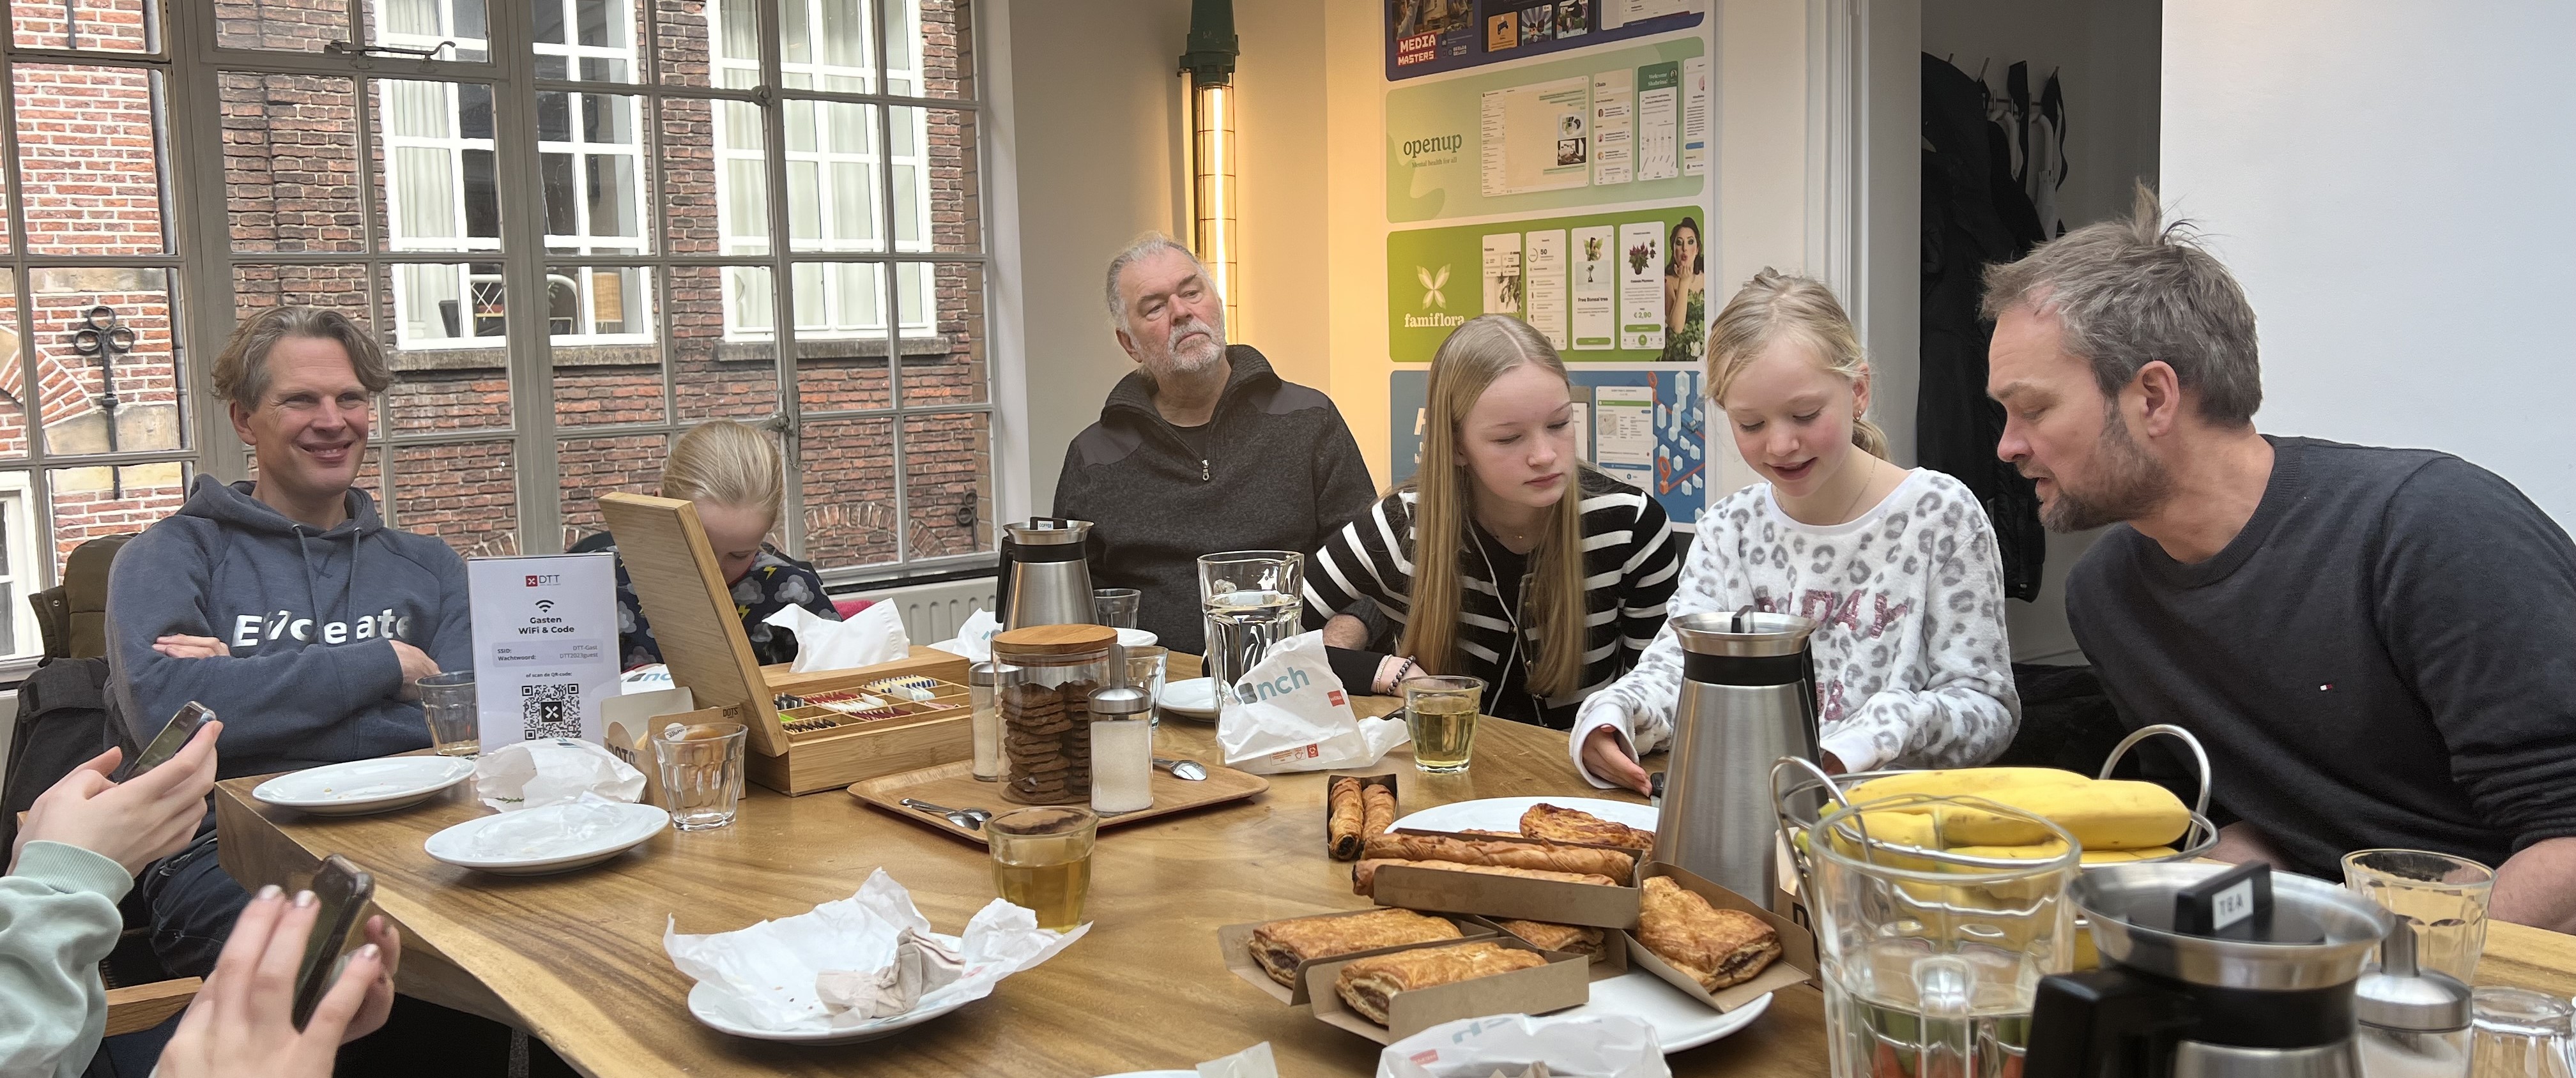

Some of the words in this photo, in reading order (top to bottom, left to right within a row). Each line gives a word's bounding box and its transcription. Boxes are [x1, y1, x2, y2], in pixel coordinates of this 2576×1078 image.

[1400, 34, 1436, 53] MEDIA
[1398, 50, 1434, 66] MASTERS
[1403, 134, 1462, 158] openup
[1404, 312, 1465, 328] famiflora
[539, 575, 560, 584] DTT
[723, 707, 739, 717] DOTS
[2219, 894, 2244, 916] TEA
